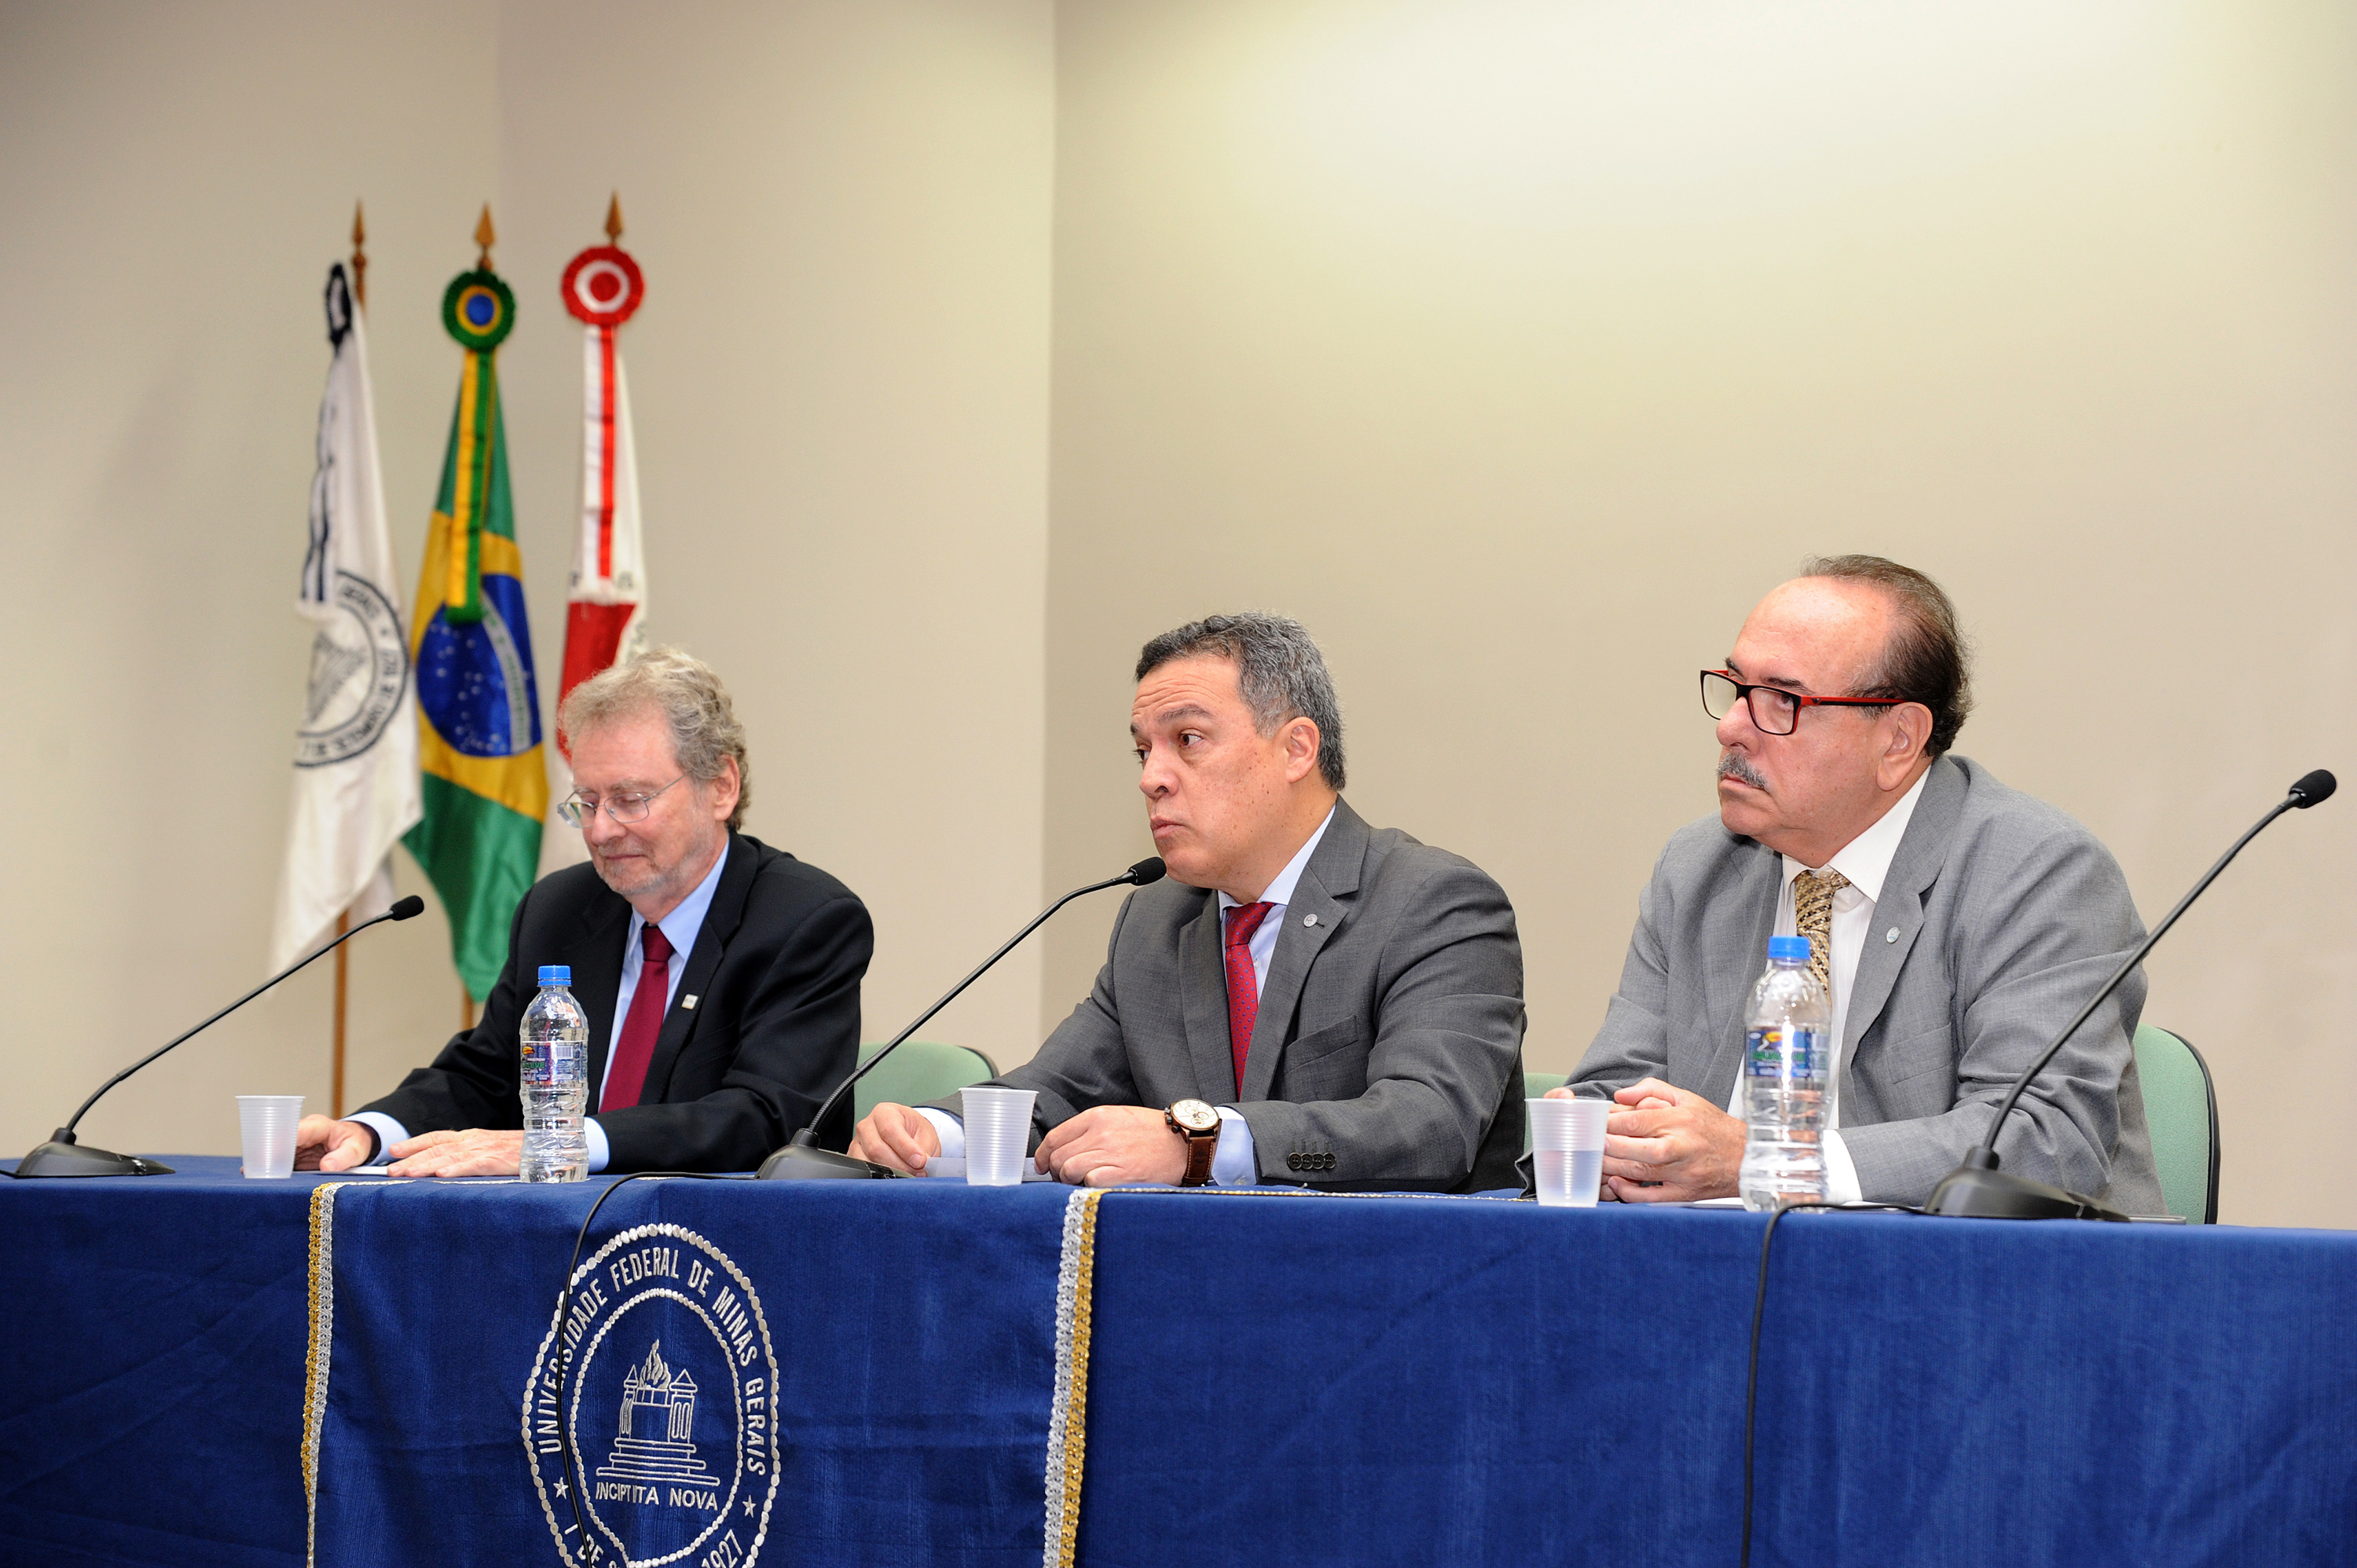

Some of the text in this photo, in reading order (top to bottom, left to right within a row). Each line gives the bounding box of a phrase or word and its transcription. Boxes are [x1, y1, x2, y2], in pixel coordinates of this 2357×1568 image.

[537, 1247, 766, 1476] UNIVERSIDADE FEDERAL DE MINAS GERAIS
[669, 1488, 718, 1511] NOVA
